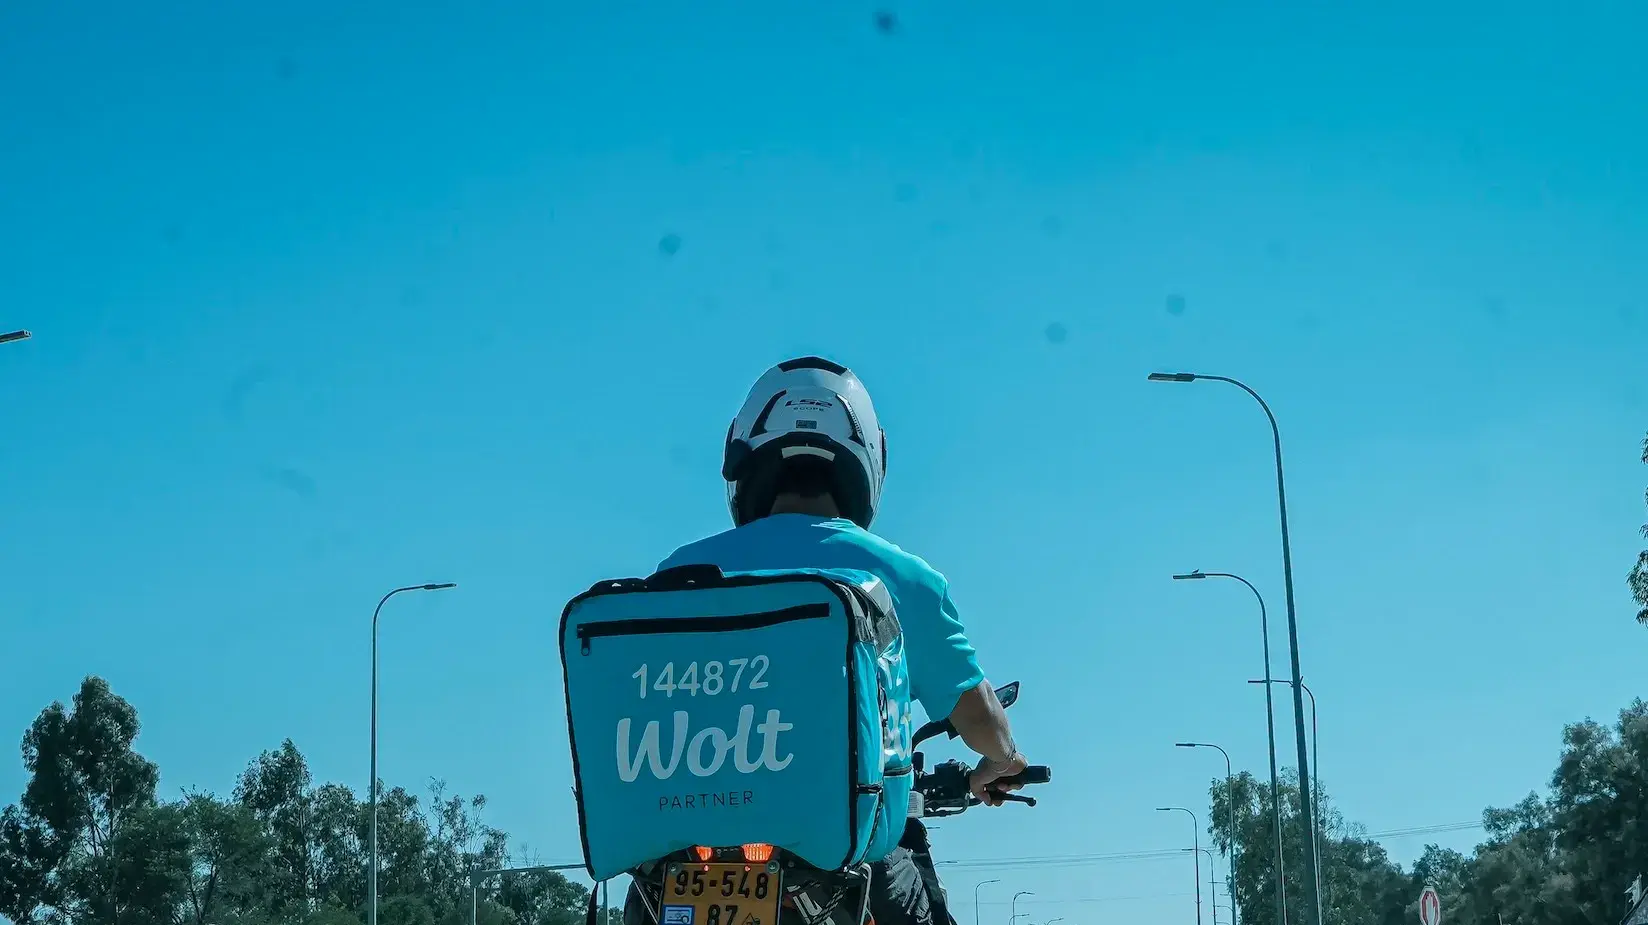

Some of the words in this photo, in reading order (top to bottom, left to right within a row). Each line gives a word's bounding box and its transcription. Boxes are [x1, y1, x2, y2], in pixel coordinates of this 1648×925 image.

[632, 655, 770, 699] 144872
[616, 704, 794, 783] Wolt
[659, 790, 753, 811] PARTNER
[674, 870, 769, 899] 95-548
[707, 904, 738, 925] 87
